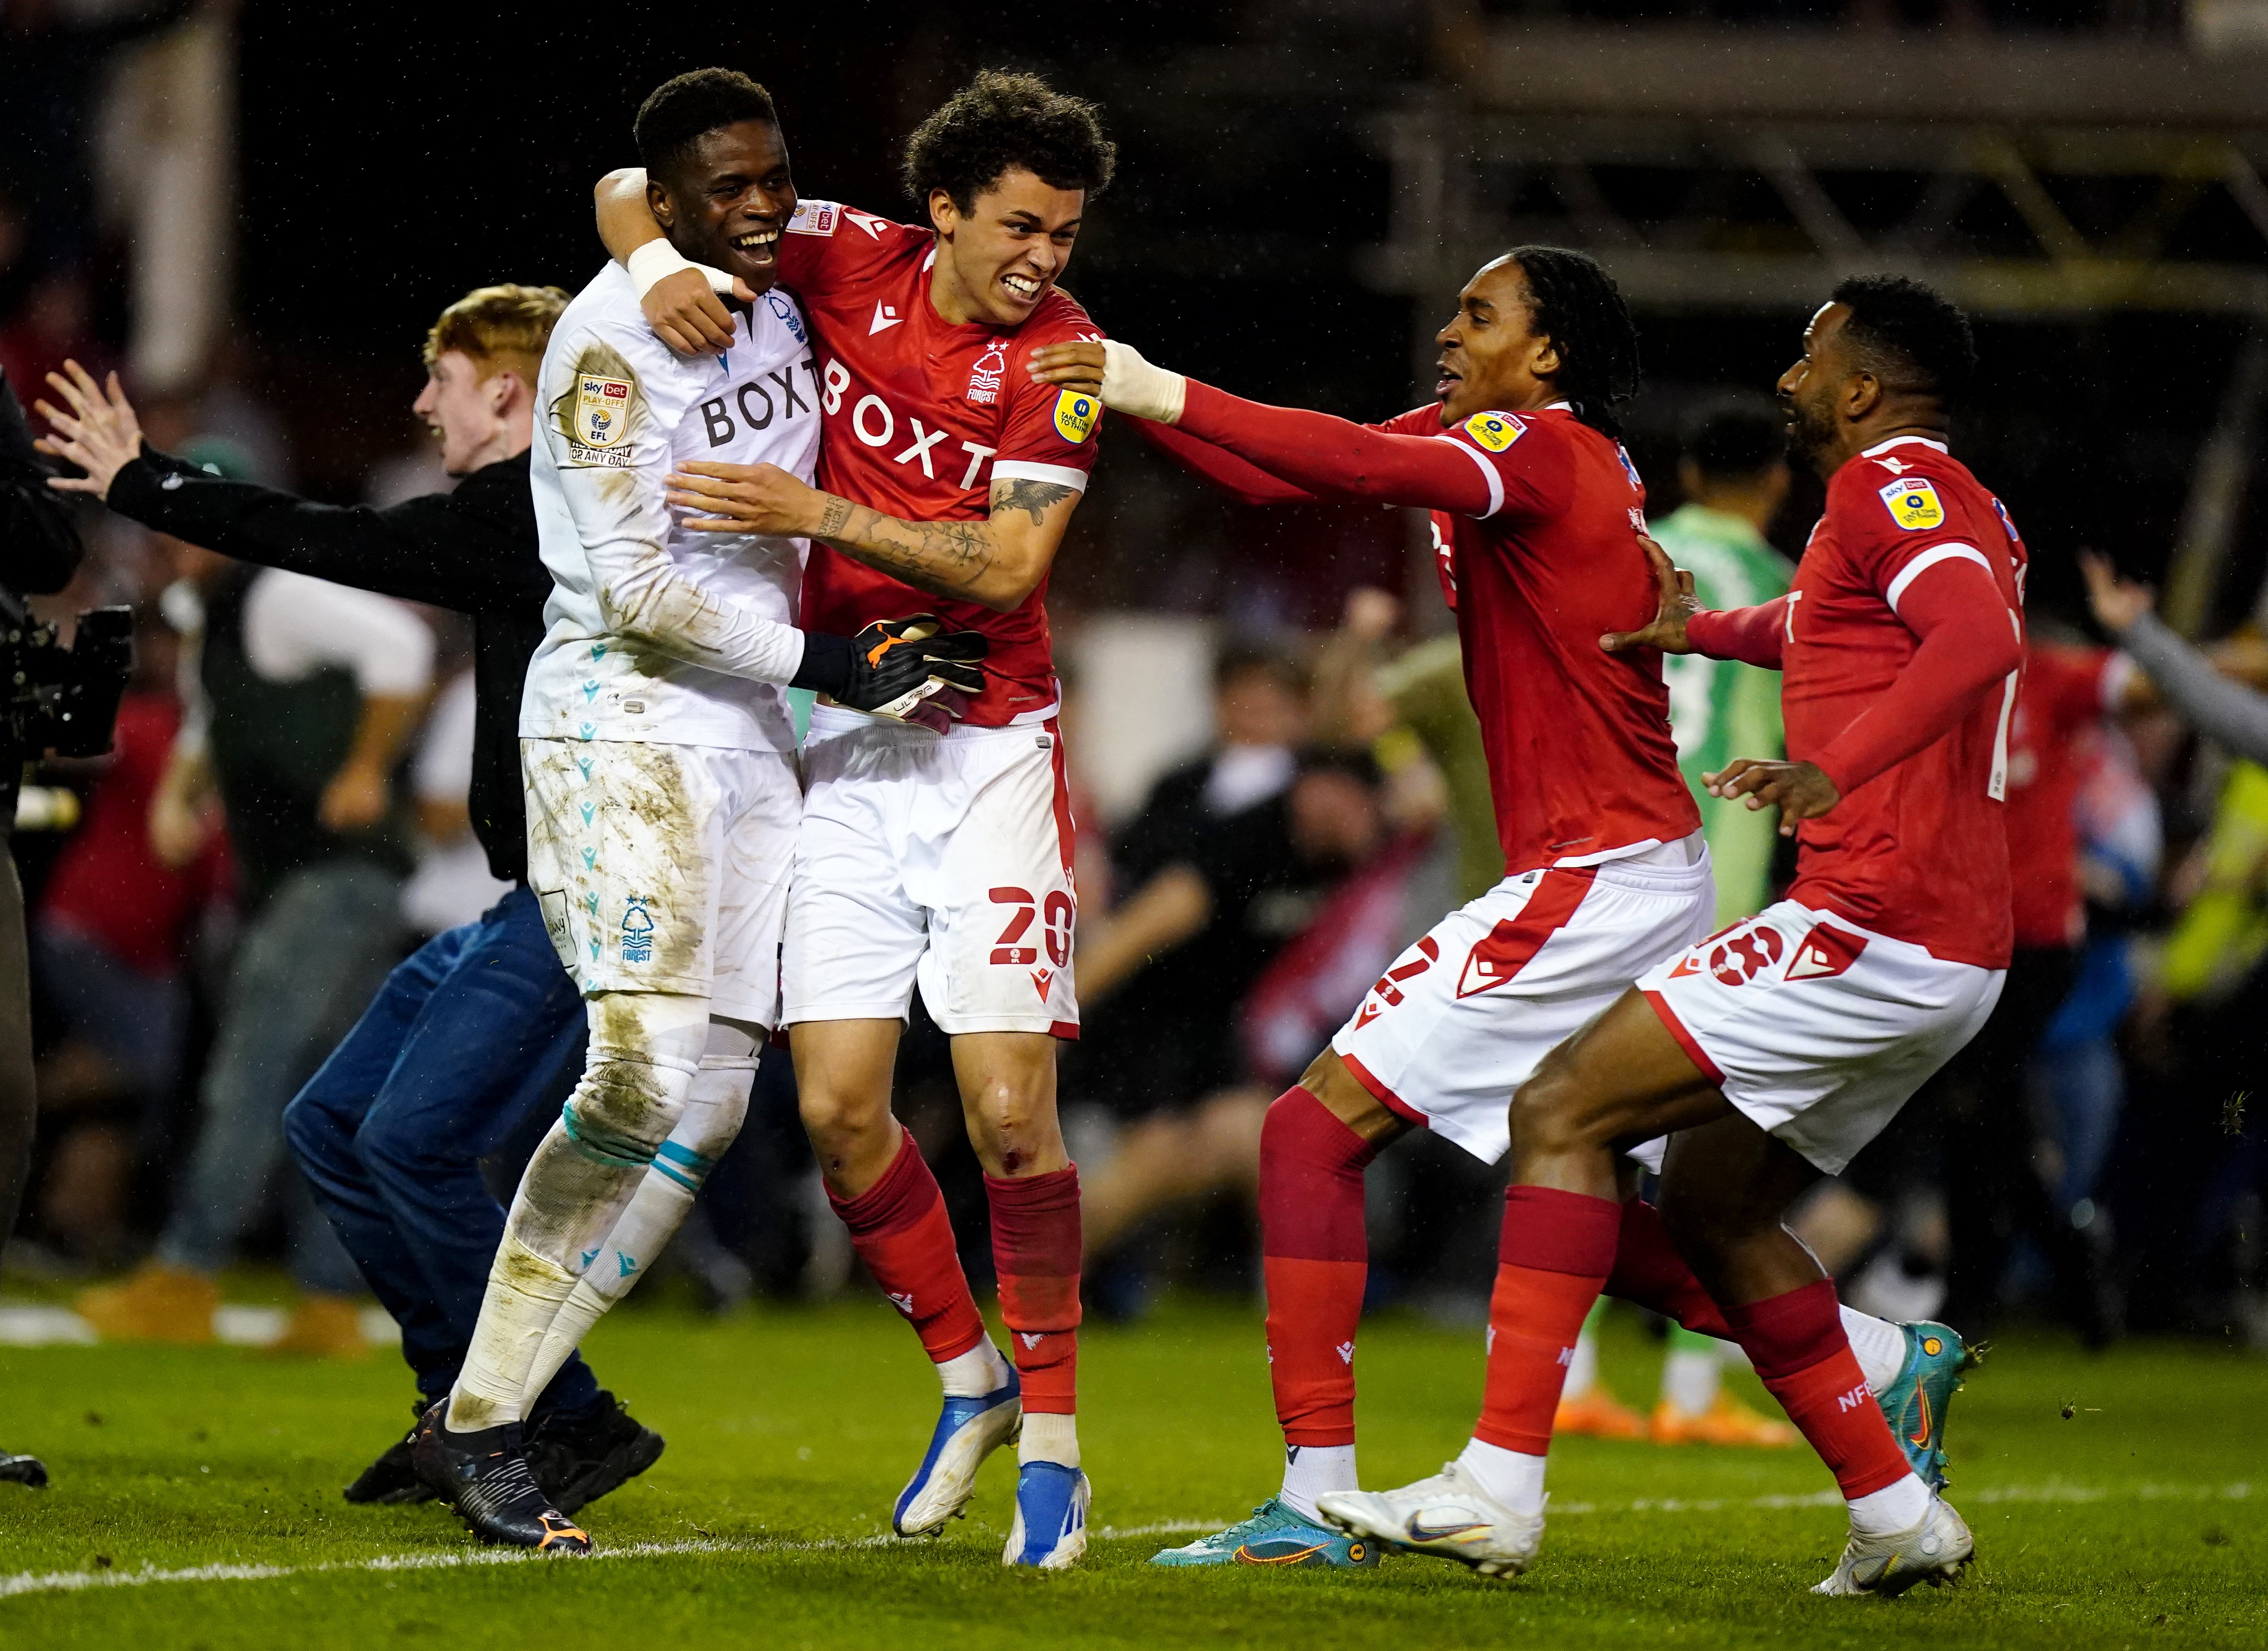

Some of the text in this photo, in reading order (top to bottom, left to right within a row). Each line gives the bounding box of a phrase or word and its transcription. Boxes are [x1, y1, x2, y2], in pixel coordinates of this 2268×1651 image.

[809, 203, 820, 228] AY-OFFS
[821, 213, 832, 228] bet
[584, 381, 626, 395] sky bet
[966, 388, 998, 404] FOREST
[583, 395, 625, 407] PLAY-OFFS
[701, 358, 820, 447] BOXT
[821, 358, 997, 490] BOXT
[1061, 412, 1077, 422] TAKE
[1061, 418, 1070, 426] TO
[591, 431, 607, 441] EFL
[571, 449, 629, 467] OR ANY DAY
[893, 685, 932, 712] ULTRA
[989, 887, 1073, 968] 20
[623, 949, 652, 963] FOREST
[1837, 1381, 1872, 1413] NFF
